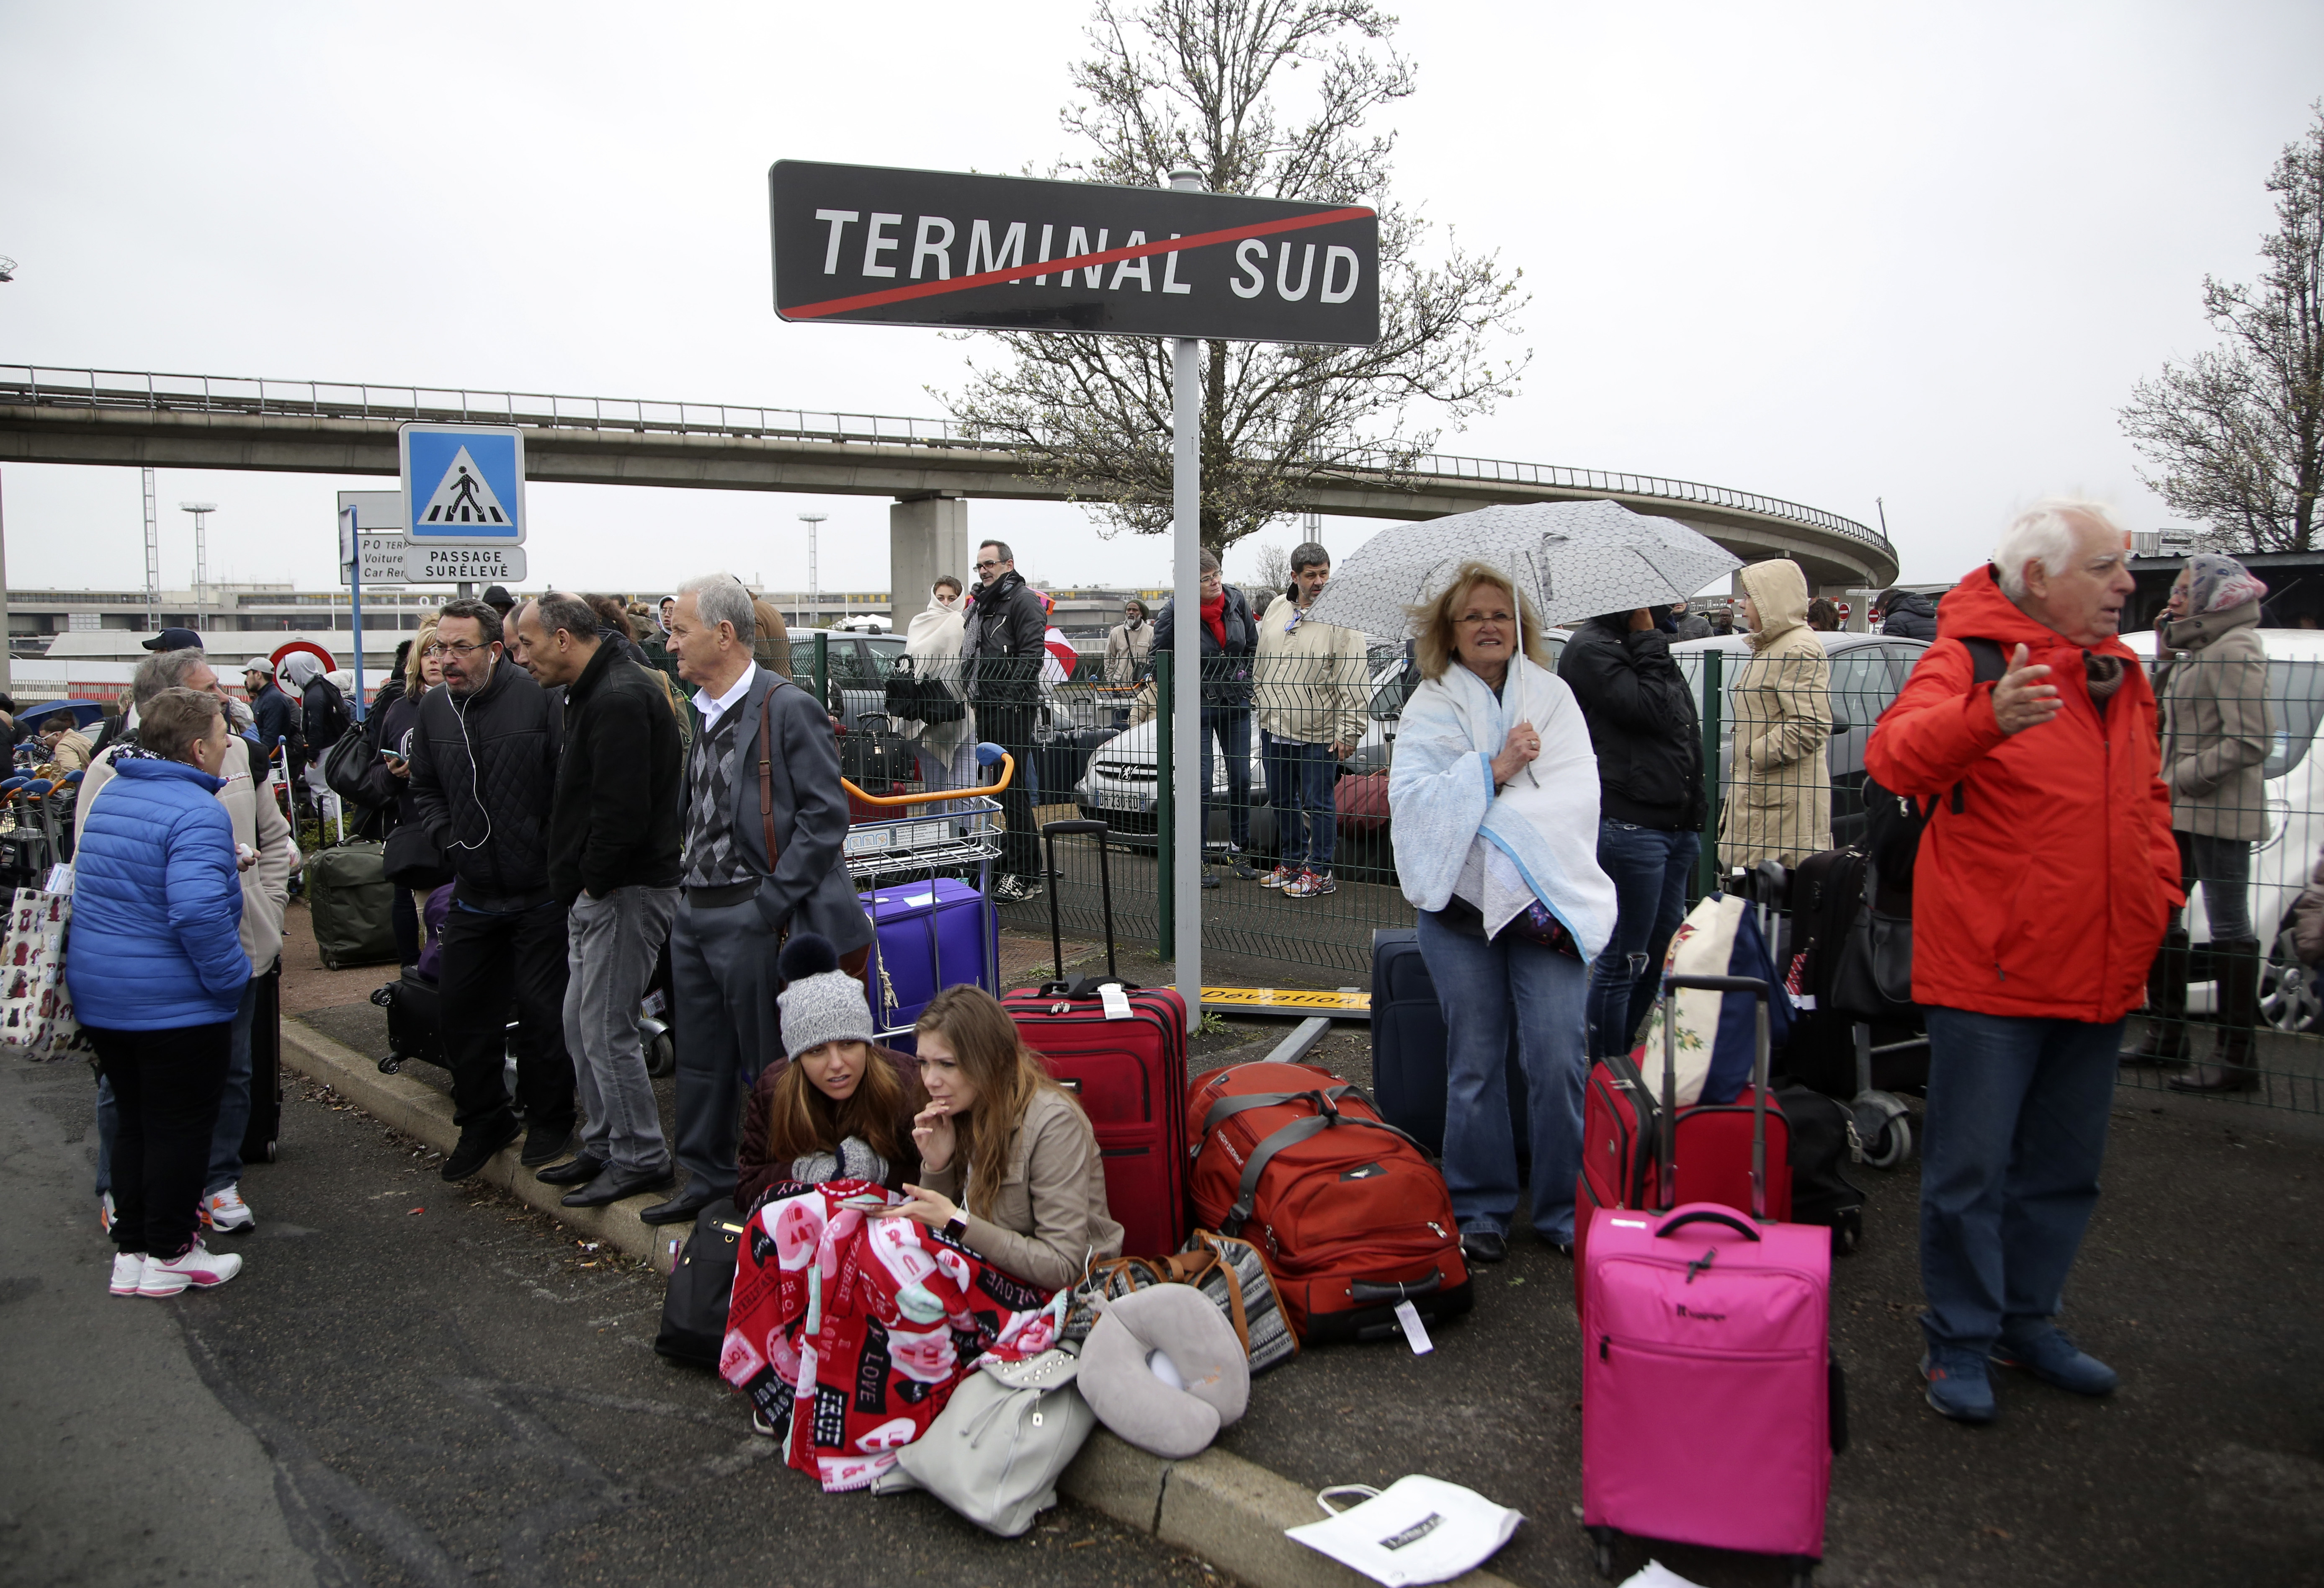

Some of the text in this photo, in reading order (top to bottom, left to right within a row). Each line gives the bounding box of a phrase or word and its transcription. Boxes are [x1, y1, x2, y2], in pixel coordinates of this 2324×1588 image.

[815, 209, 1359, 304] TERMINAL SUD
[430, 551, 502, 562] PASSAGE
[364, 568, 383, 577] Car
[425, 563, 508, 577] SURÉLEVÉ
[1201, 990, 1355, 1005] Déviation
[861, 1351, 884, 1403] LOVE
[818, 1391, 843, 1446] TRUE
